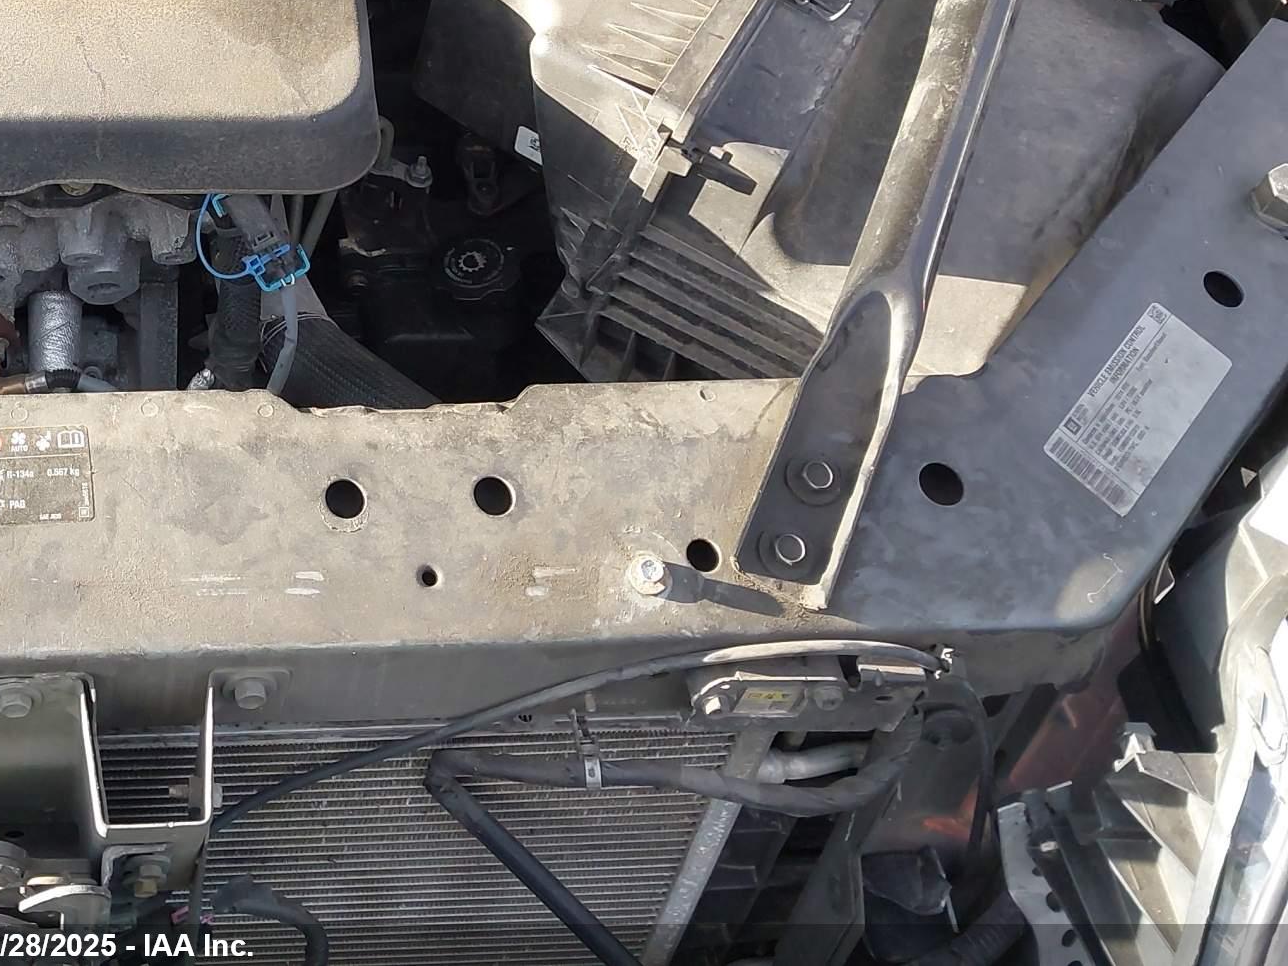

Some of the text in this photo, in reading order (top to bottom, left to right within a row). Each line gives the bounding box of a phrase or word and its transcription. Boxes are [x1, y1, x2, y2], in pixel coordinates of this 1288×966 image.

[1087, 373, 1109, 397] VEHICLE
[1104, 348, 1128, 376] EMISSION
[1123, 325, 1146, 350] CONTROL
[1109, 346, 1140, 384] INFORMATION
[69, 466, 80, 477] kg
